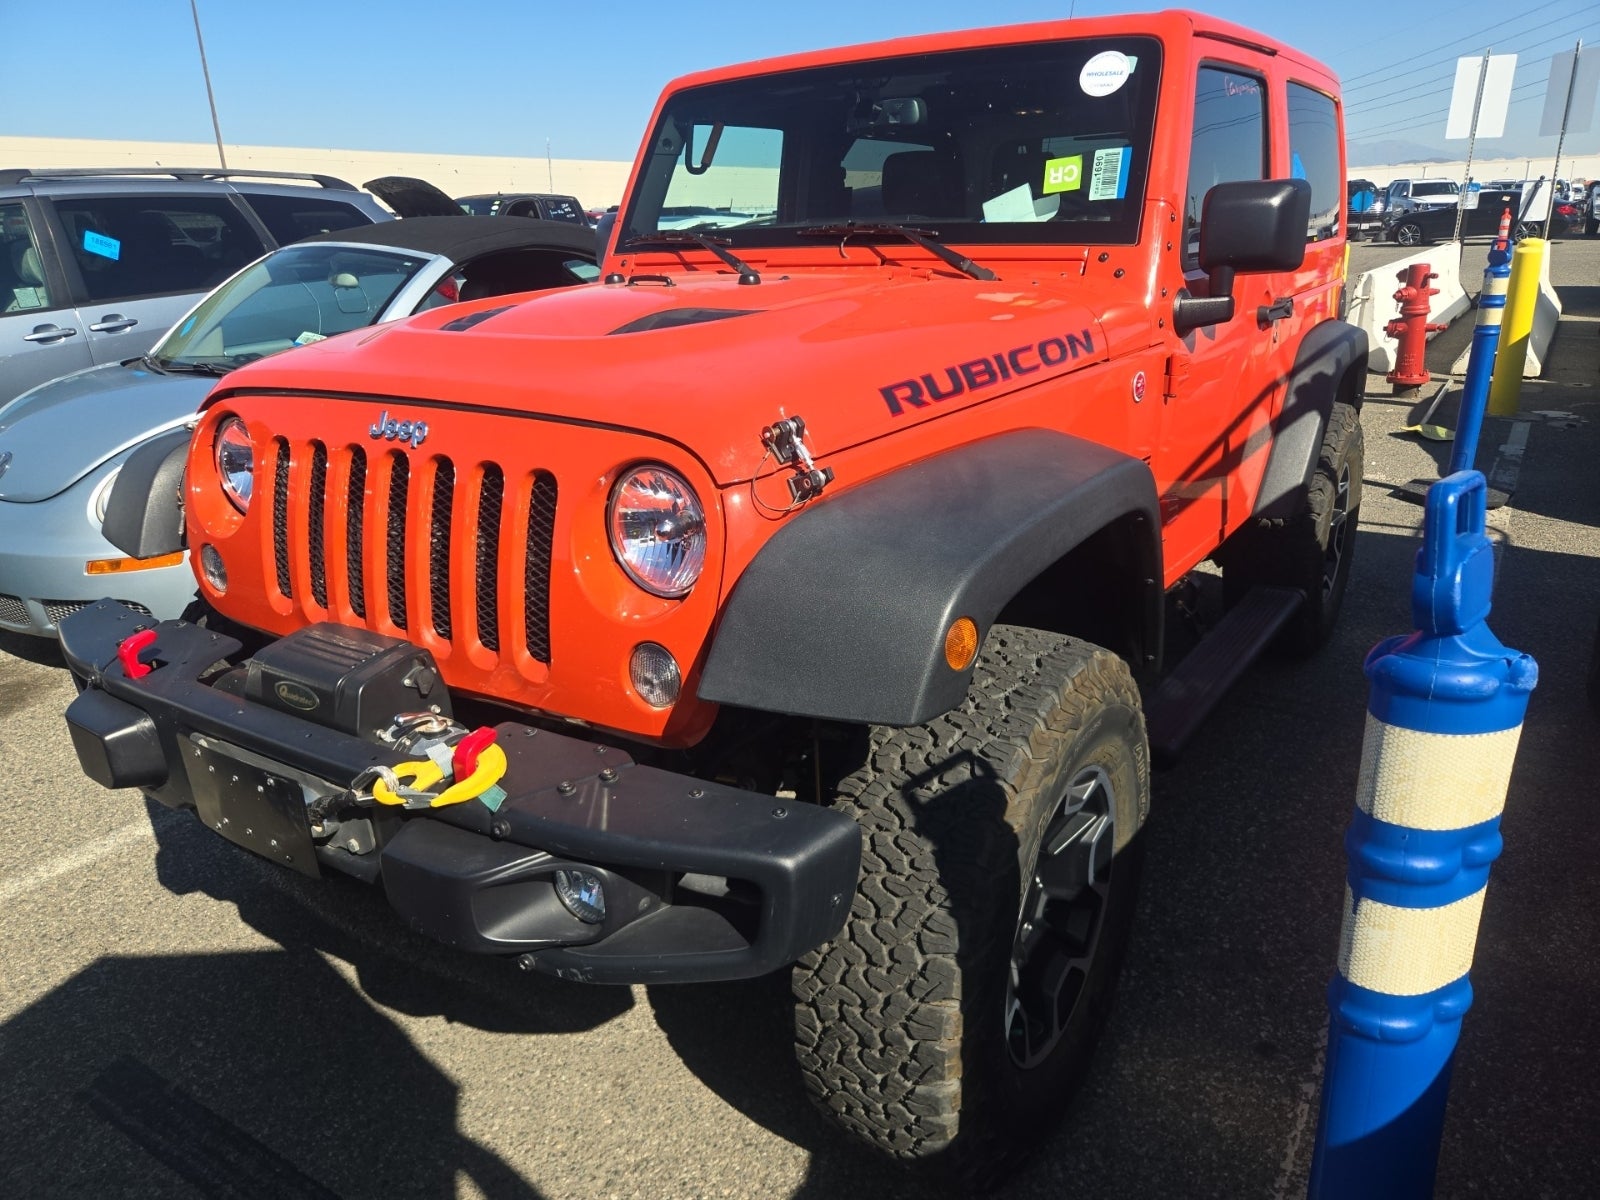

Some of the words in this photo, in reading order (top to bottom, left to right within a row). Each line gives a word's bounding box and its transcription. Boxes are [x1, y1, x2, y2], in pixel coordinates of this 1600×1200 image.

[1050, 164, 1078, 184] CR
[879, 329, 1095, 417] RUBICON
[369, 410, 428, 448] Jeep
